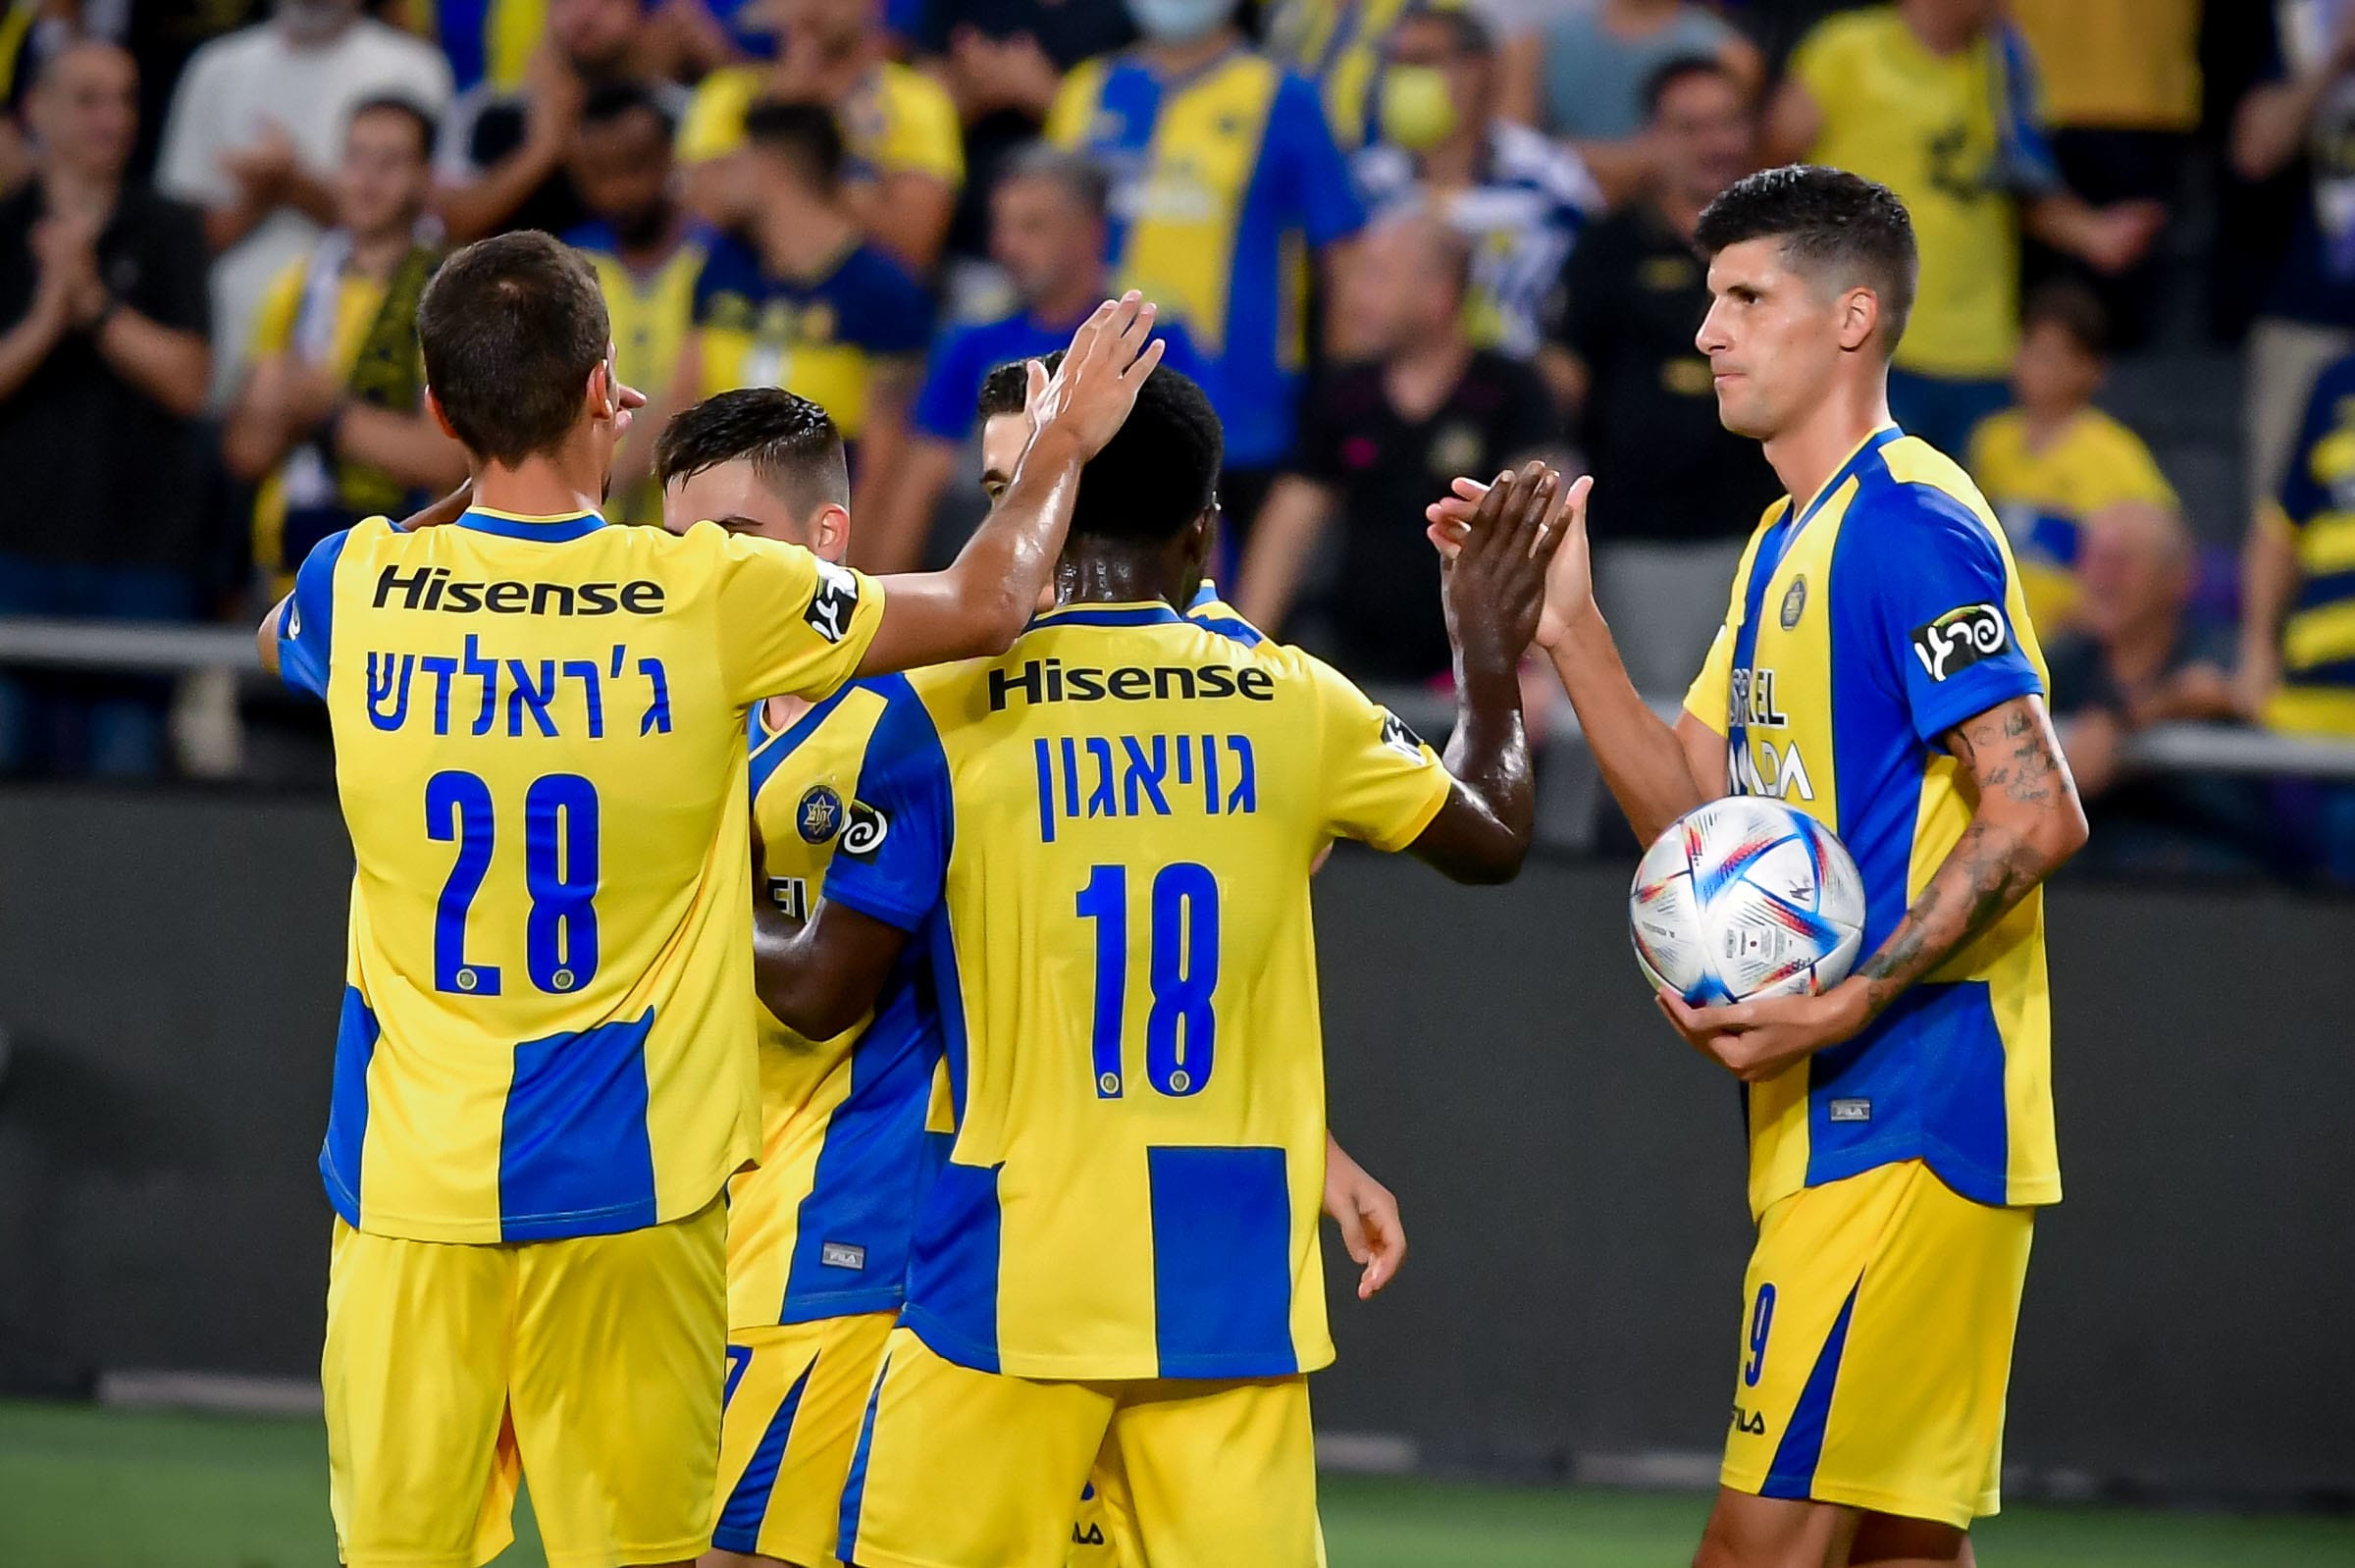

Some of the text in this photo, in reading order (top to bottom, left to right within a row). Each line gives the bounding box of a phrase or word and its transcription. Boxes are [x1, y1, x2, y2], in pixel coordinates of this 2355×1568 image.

[372, 564, 665, 616] Hisense
[367, 633, 672, 739] ג'ראלדש
[988, 658, 1274, 711] Hisense
[1034, 734, 1257, 843] גויאגון
[425, 769, 601, 996] 28
[1075, 861, 1220, 1099] 18
[1744, 1281, 1777, 1388] 9
